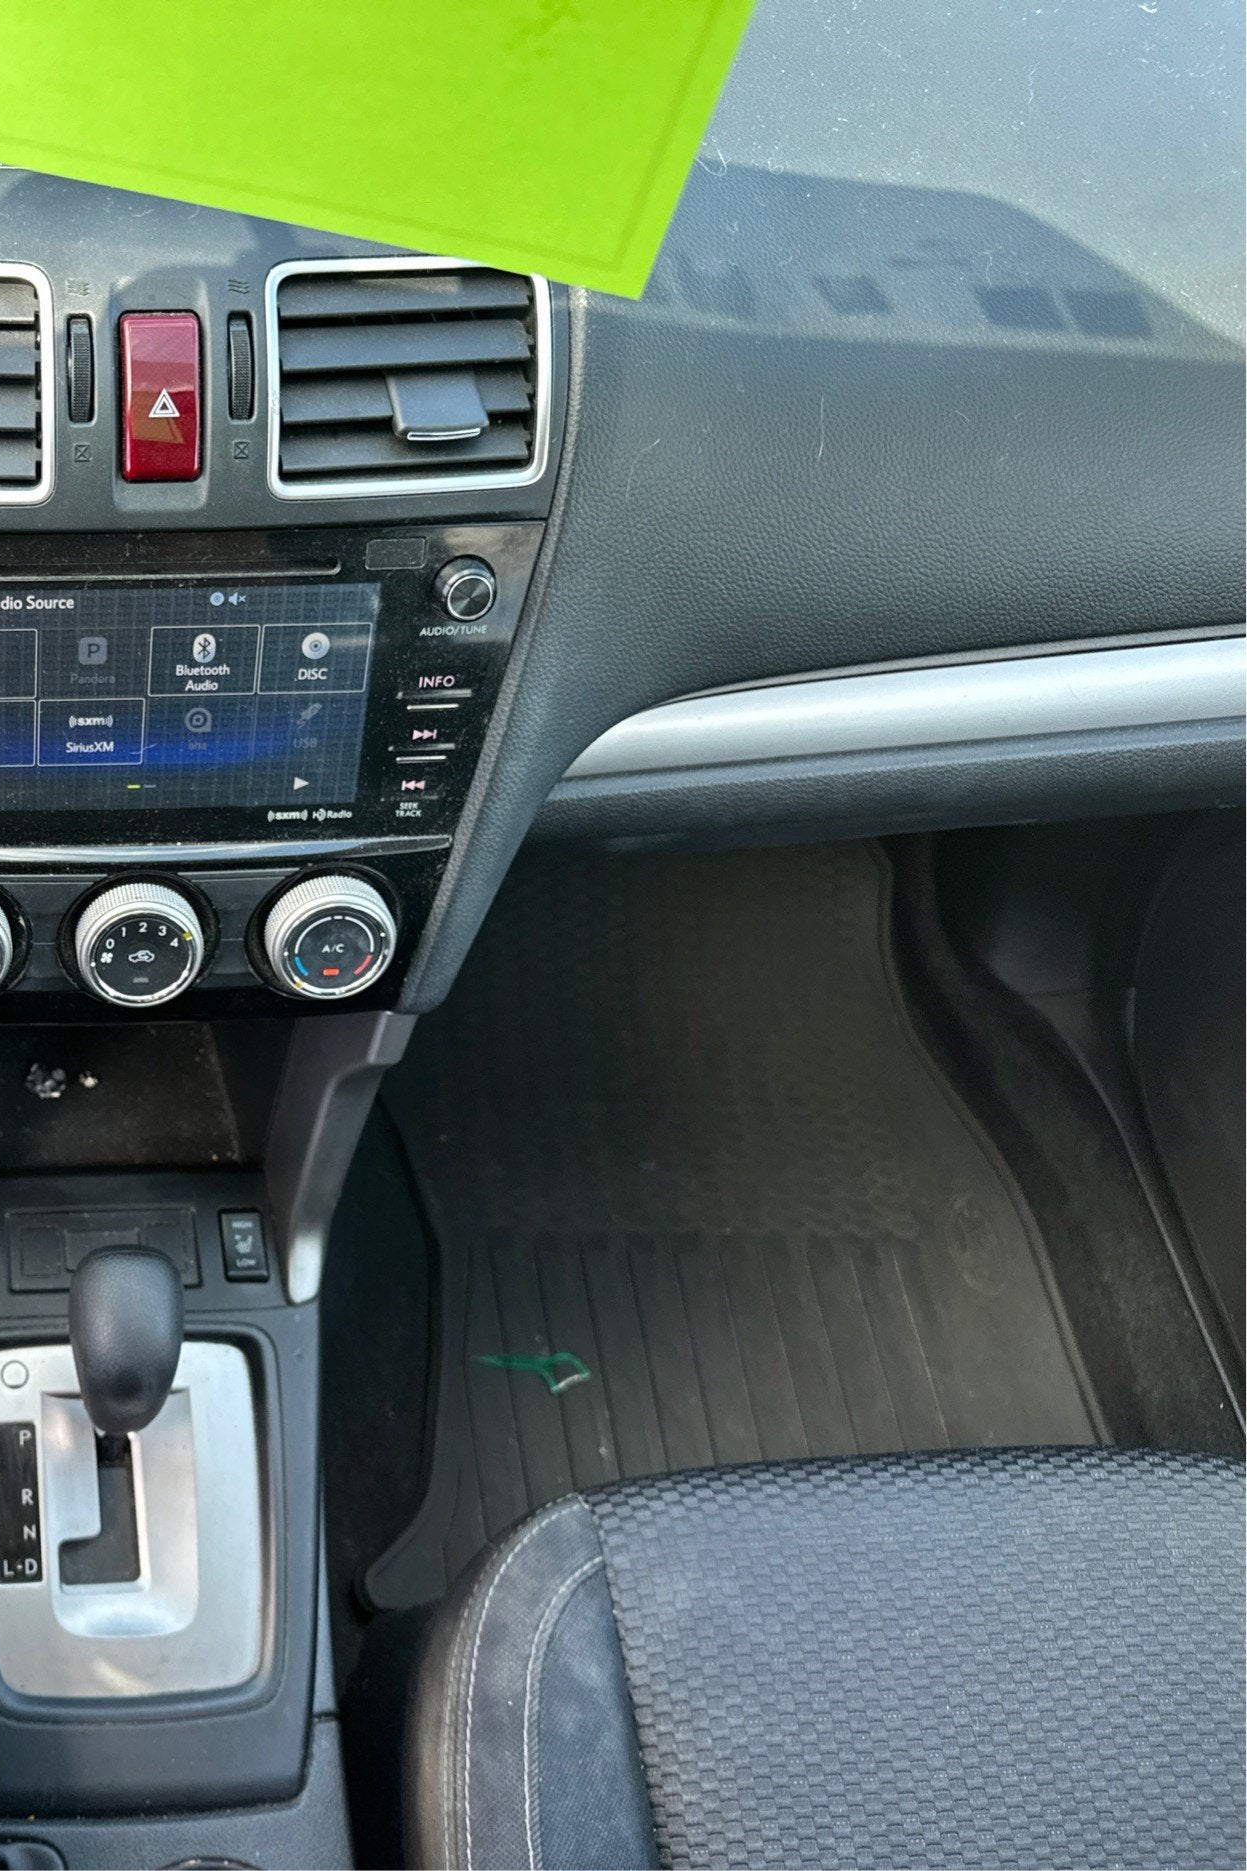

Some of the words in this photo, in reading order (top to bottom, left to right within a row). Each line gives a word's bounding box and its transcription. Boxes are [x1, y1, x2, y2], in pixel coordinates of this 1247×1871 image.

[26, 595, 75, 609] Source
[419, 624, 488, 637] AUDIO/TUNE
[175, 663, 231, 676] Bluetooth
[297, 668, 328, 681] DISC
[70, 673, 116, 685] Pandora
[418, 676, 456, 688] INFO
[185, 680, 219, 692] Audio
[65, 740, 114, 753] SiriusXM
[293, 737, 319, 749] USB
[327, 810, 353, 819] Radio
[121, 927, 127, 937] 1
[139, 922, 148, 933] 2
[158, 926, 167, 936] 3
[105, 938, 115, 949] 0
[170, 937, 179, 948] 4
[321, 943, 345, 953] A/C
[19, 1430, 32, 1447] P
[21, 1488, 33, 1505] R
[23, 1525, 37, 1541] N
